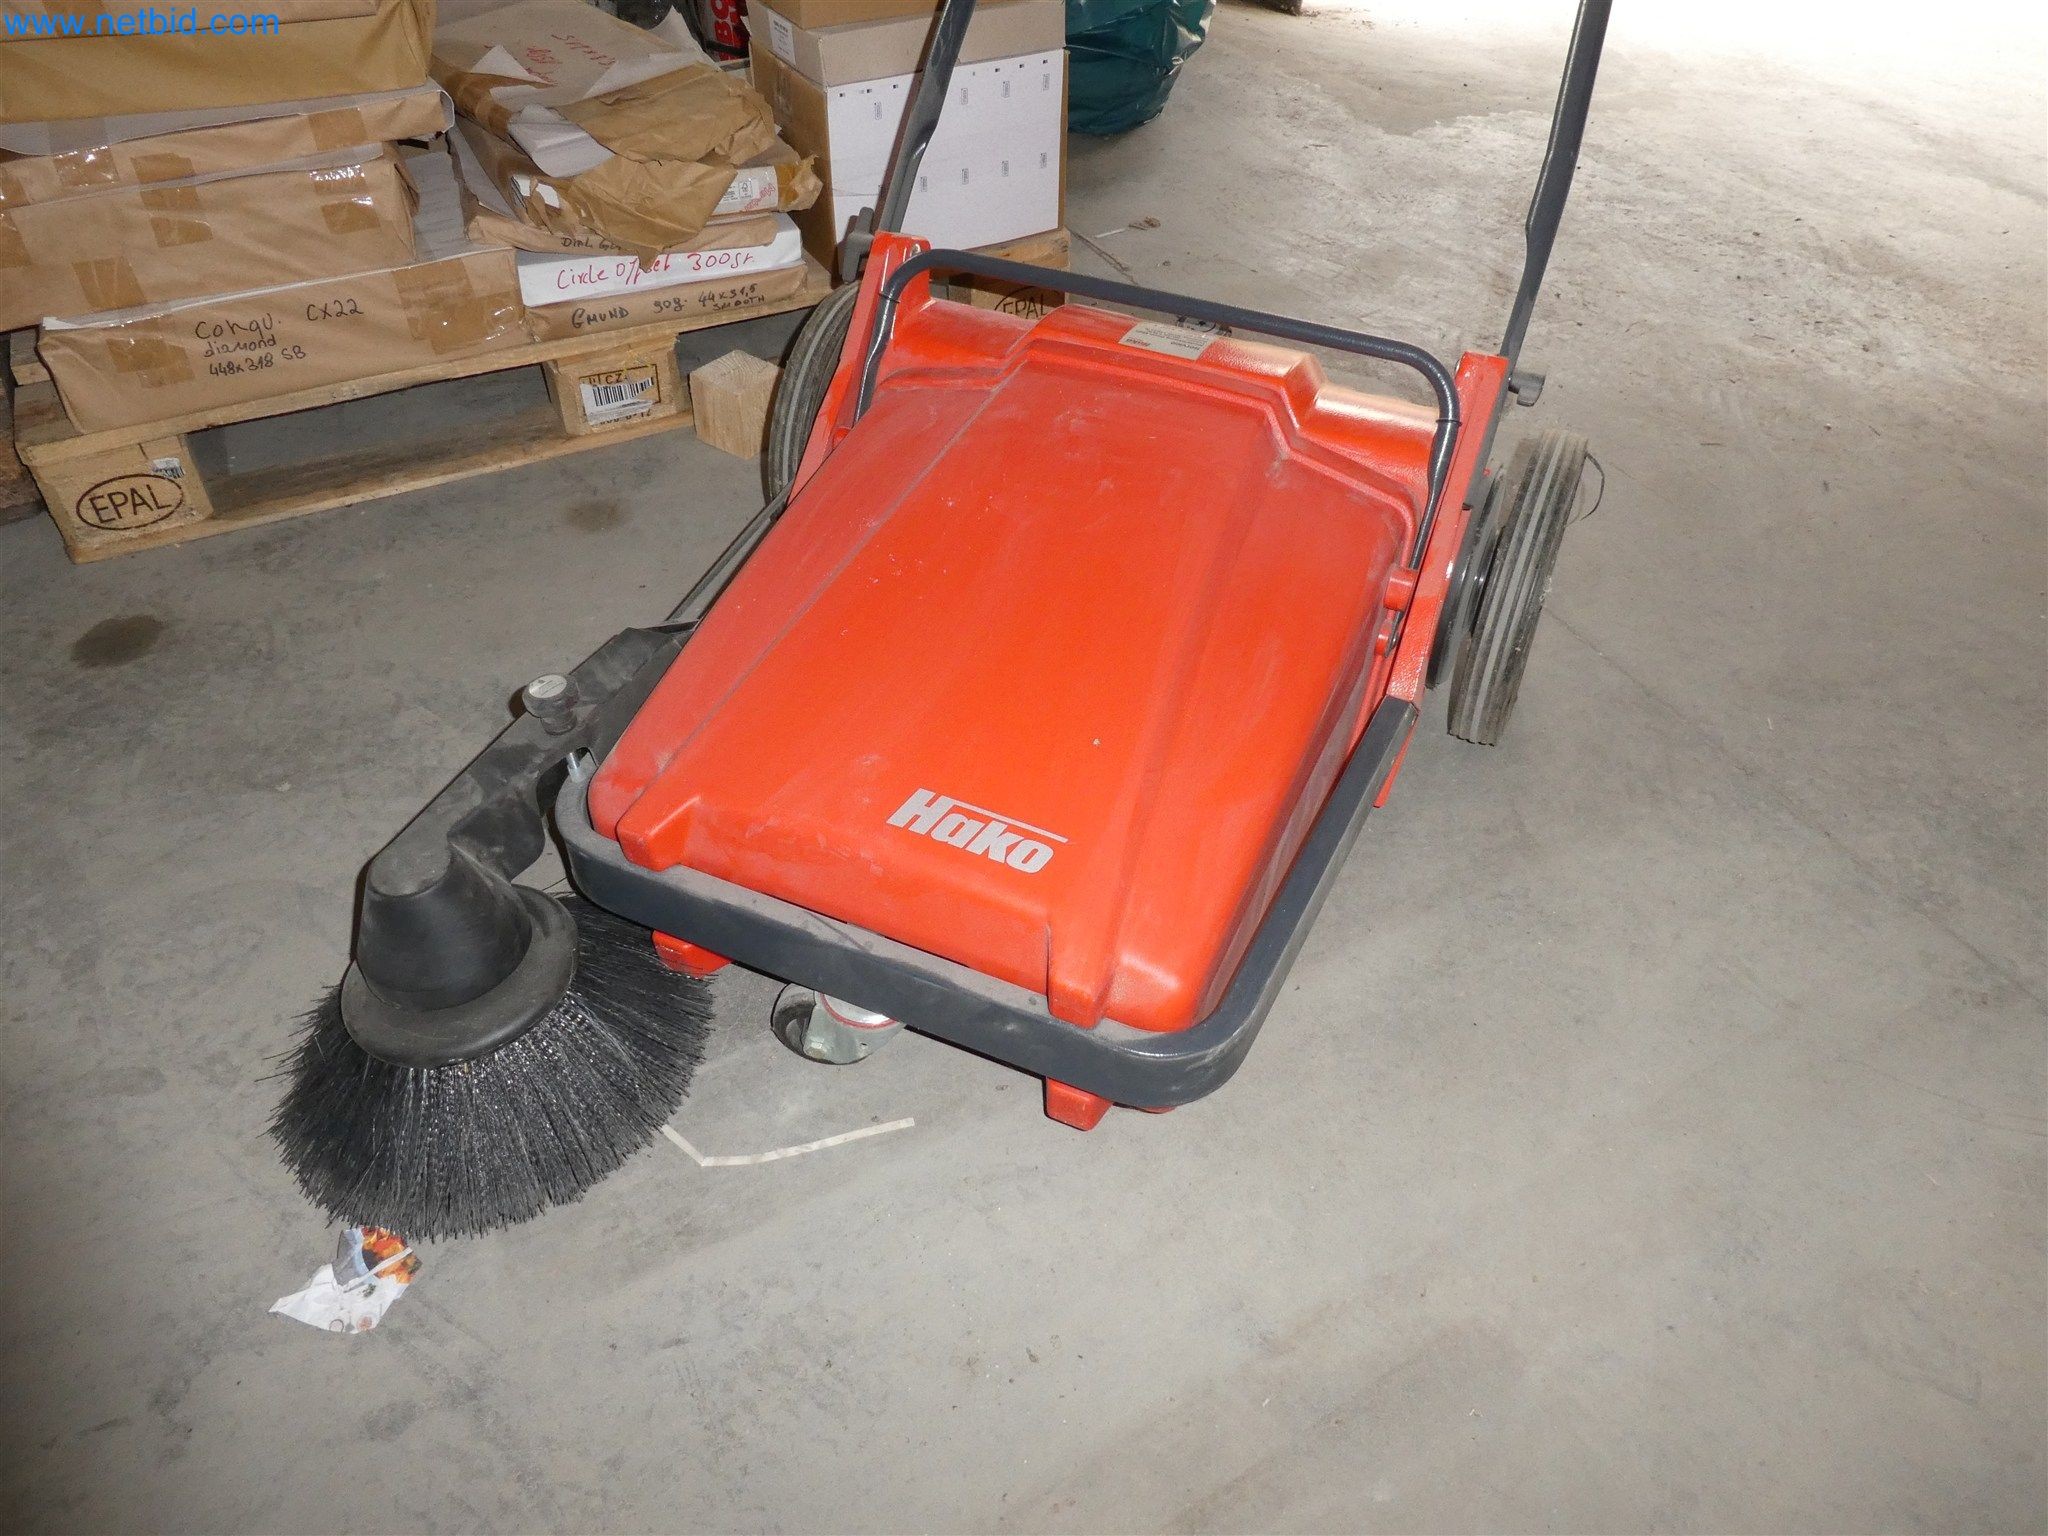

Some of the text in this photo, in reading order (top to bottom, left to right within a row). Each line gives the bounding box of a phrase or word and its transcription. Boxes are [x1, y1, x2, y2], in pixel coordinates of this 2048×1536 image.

[557, 265, 609, 290] Circle
[616, 254, 670, 286] Offet
[306, 298, 364, 322] CX22
[209, 345, 306, 377] 448x318 SB
[88, 484, 172, 524] EPAL
[885, 787, 1055, 874] Hako
